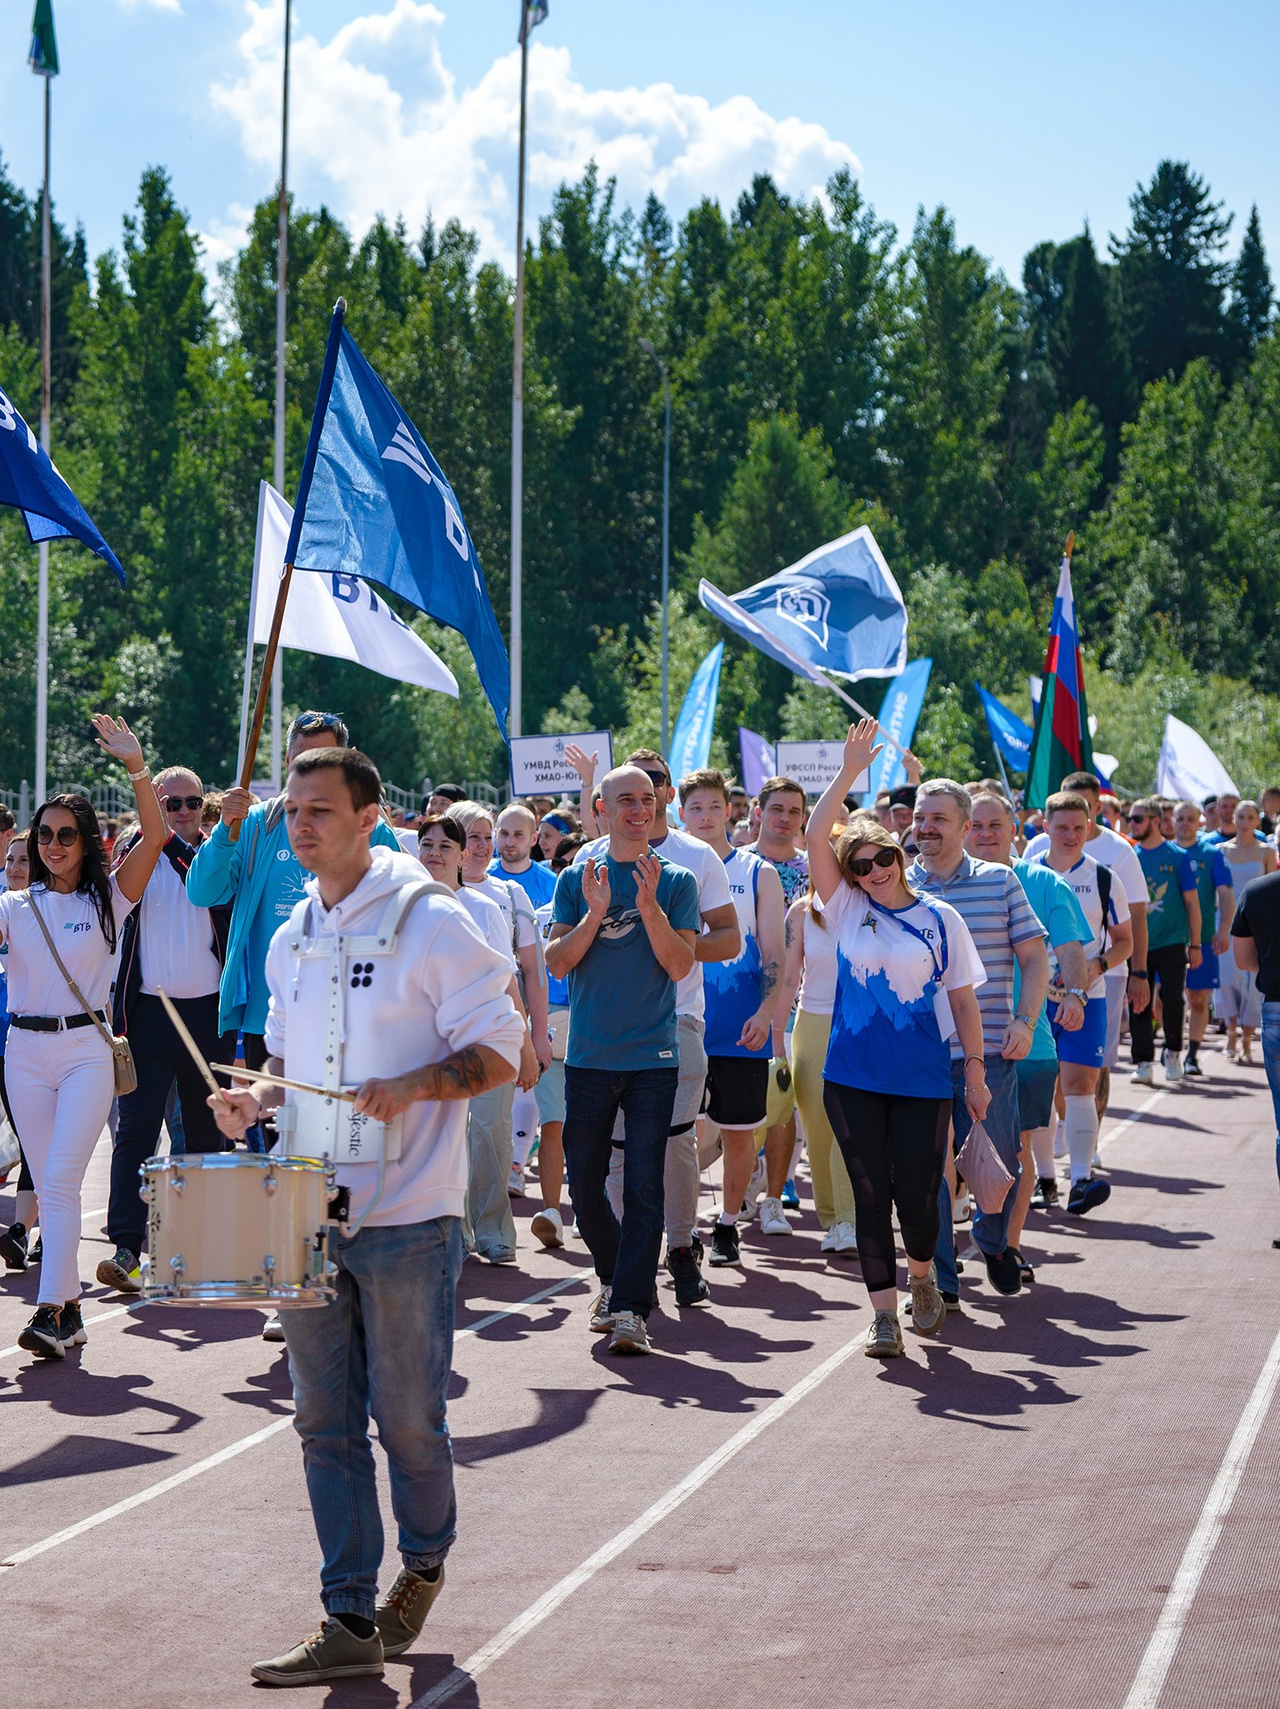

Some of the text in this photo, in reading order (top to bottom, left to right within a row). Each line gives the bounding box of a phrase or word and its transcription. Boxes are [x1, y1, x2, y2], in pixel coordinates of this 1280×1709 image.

[523, 760, 551, 770] УМВД
[818, 763, 842, 771] Росси
[534, 772, 582, 782] ХМАО-Юг
[798, 775, 834, 783] ХМАО-Ю
[1075, 885, 1091, 893] ВТБ
[73, 922, 91, 933] ВТБ
[920, 928, 934, 939] ТБ
[347, 1106, 363, 1158] jestic
